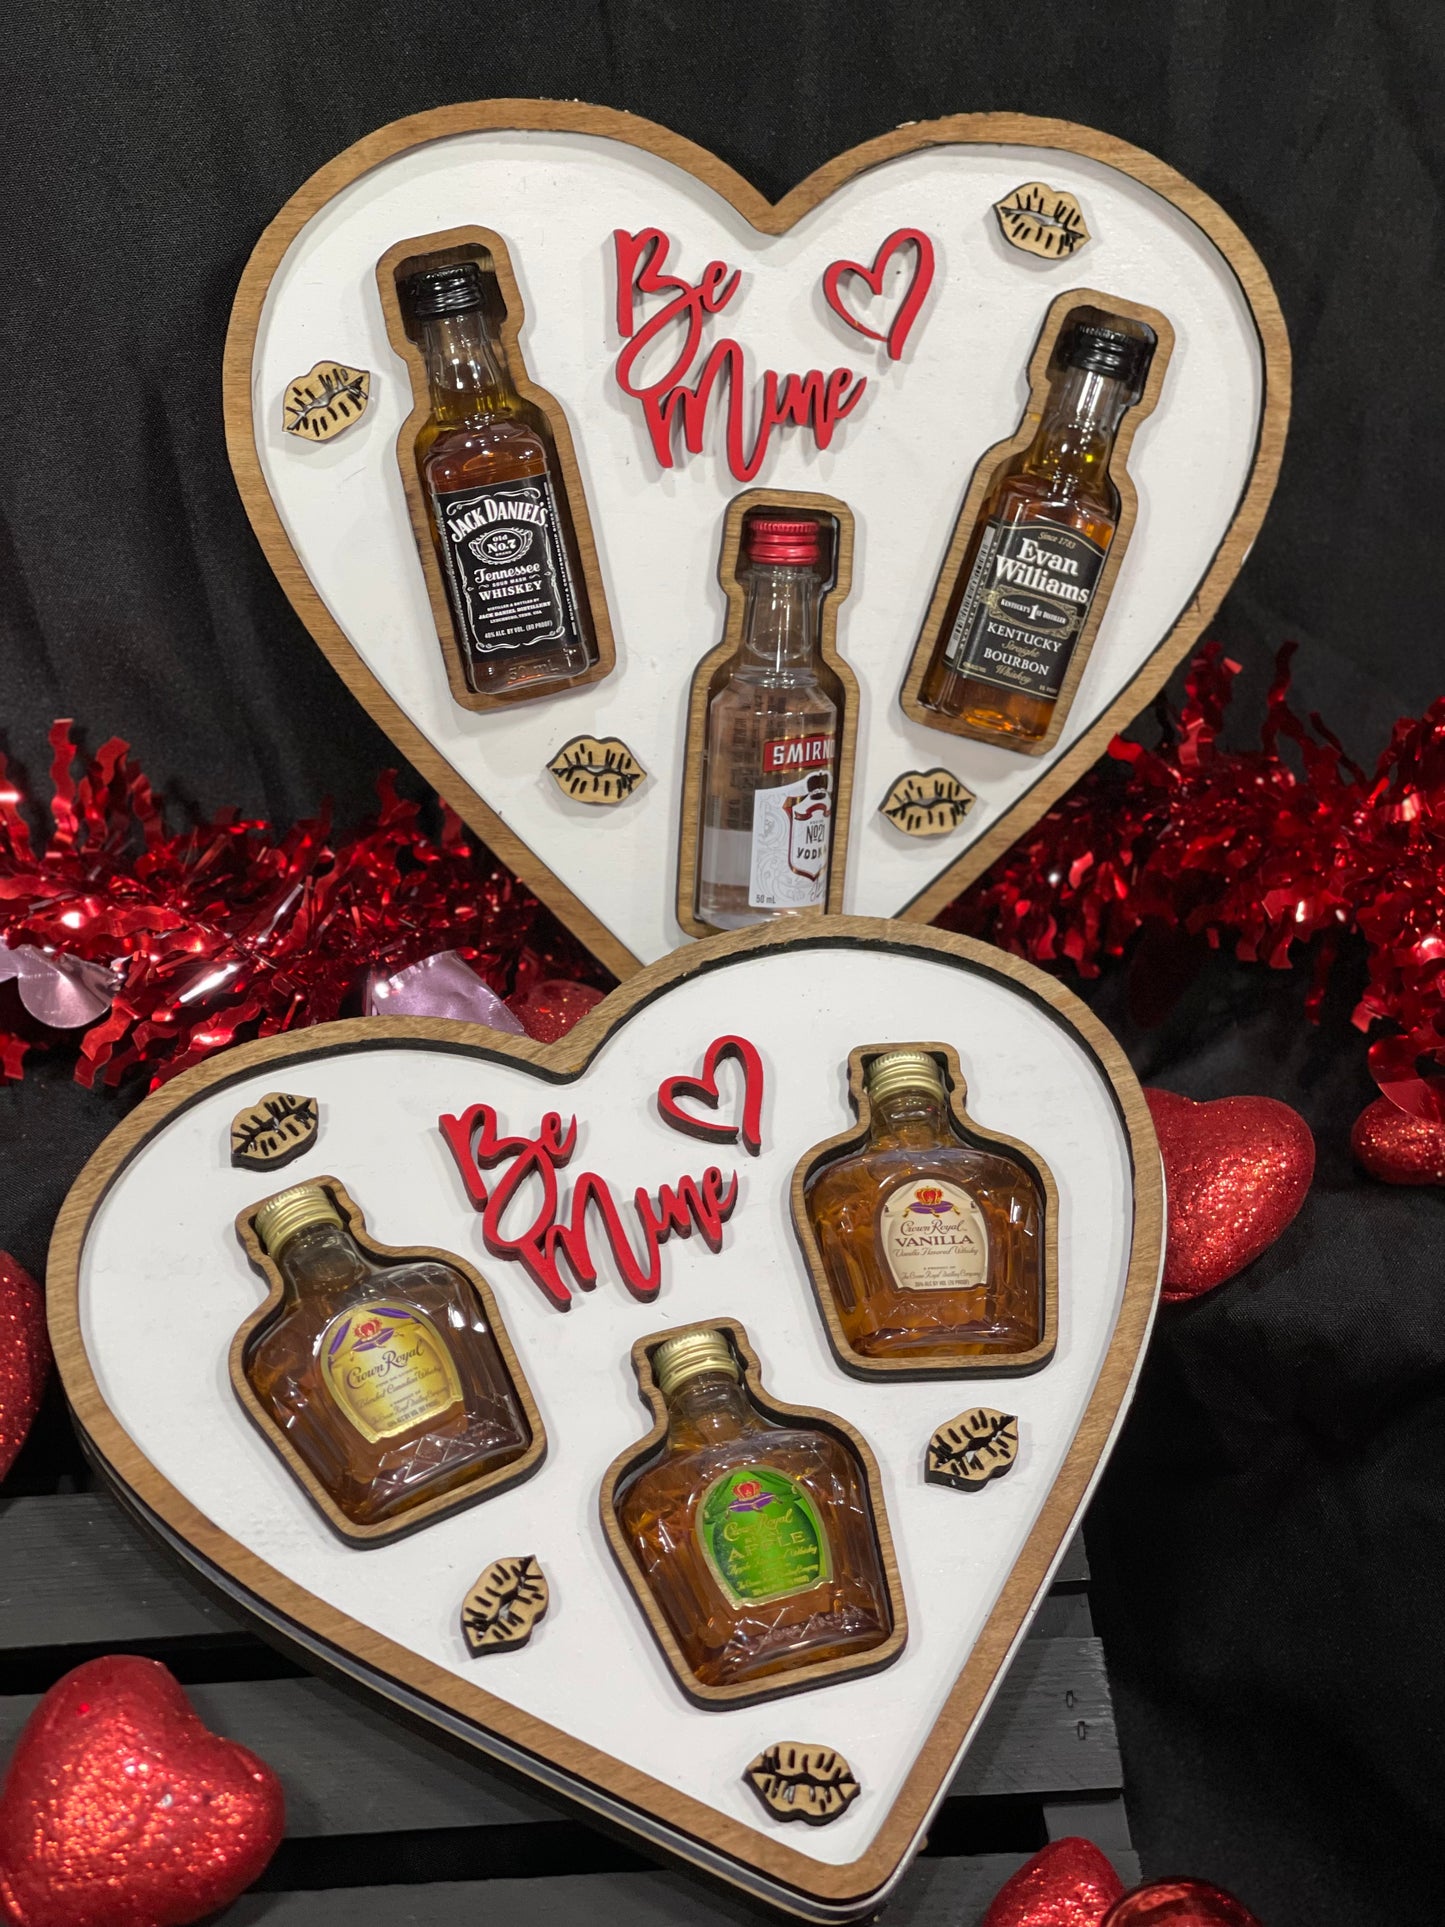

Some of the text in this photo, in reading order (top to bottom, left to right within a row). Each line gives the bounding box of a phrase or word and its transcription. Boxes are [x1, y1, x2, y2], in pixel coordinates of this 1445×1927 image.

[614, 227, 742, 398] Be
[447, 499, 548, 542] JACK DANIEL'S
[487, 539, 517, 553] No.7
[492, 534, 508, 542] Old
[1038, 531, 1077, 549] Since 1783
[1016, 537, 1079, 577] Evan
[474, 563, 540, 583] Tennessee
[996, 554, 1090, 604] Williams
[478, 580, 542, 601] WHISKEY
[960, 542, 998, 649] EXTRA AGED IN OAK
[987, 621, 1063, 653] KENTUCKY
[1001, 640, 1040, 658] Straight
[984, 647, 1050, 676] BOURBON
[755, 894, 776, 904] 50 mL
[438, 1103, 578, 1260] Be
[900, 1219, 965, 1236] Crown Royal
[895, 1235, 975, 1247] VANILLA
[347, 1364, 384, 1389] Crown
[378, 1338, 424, 1377] Royal
